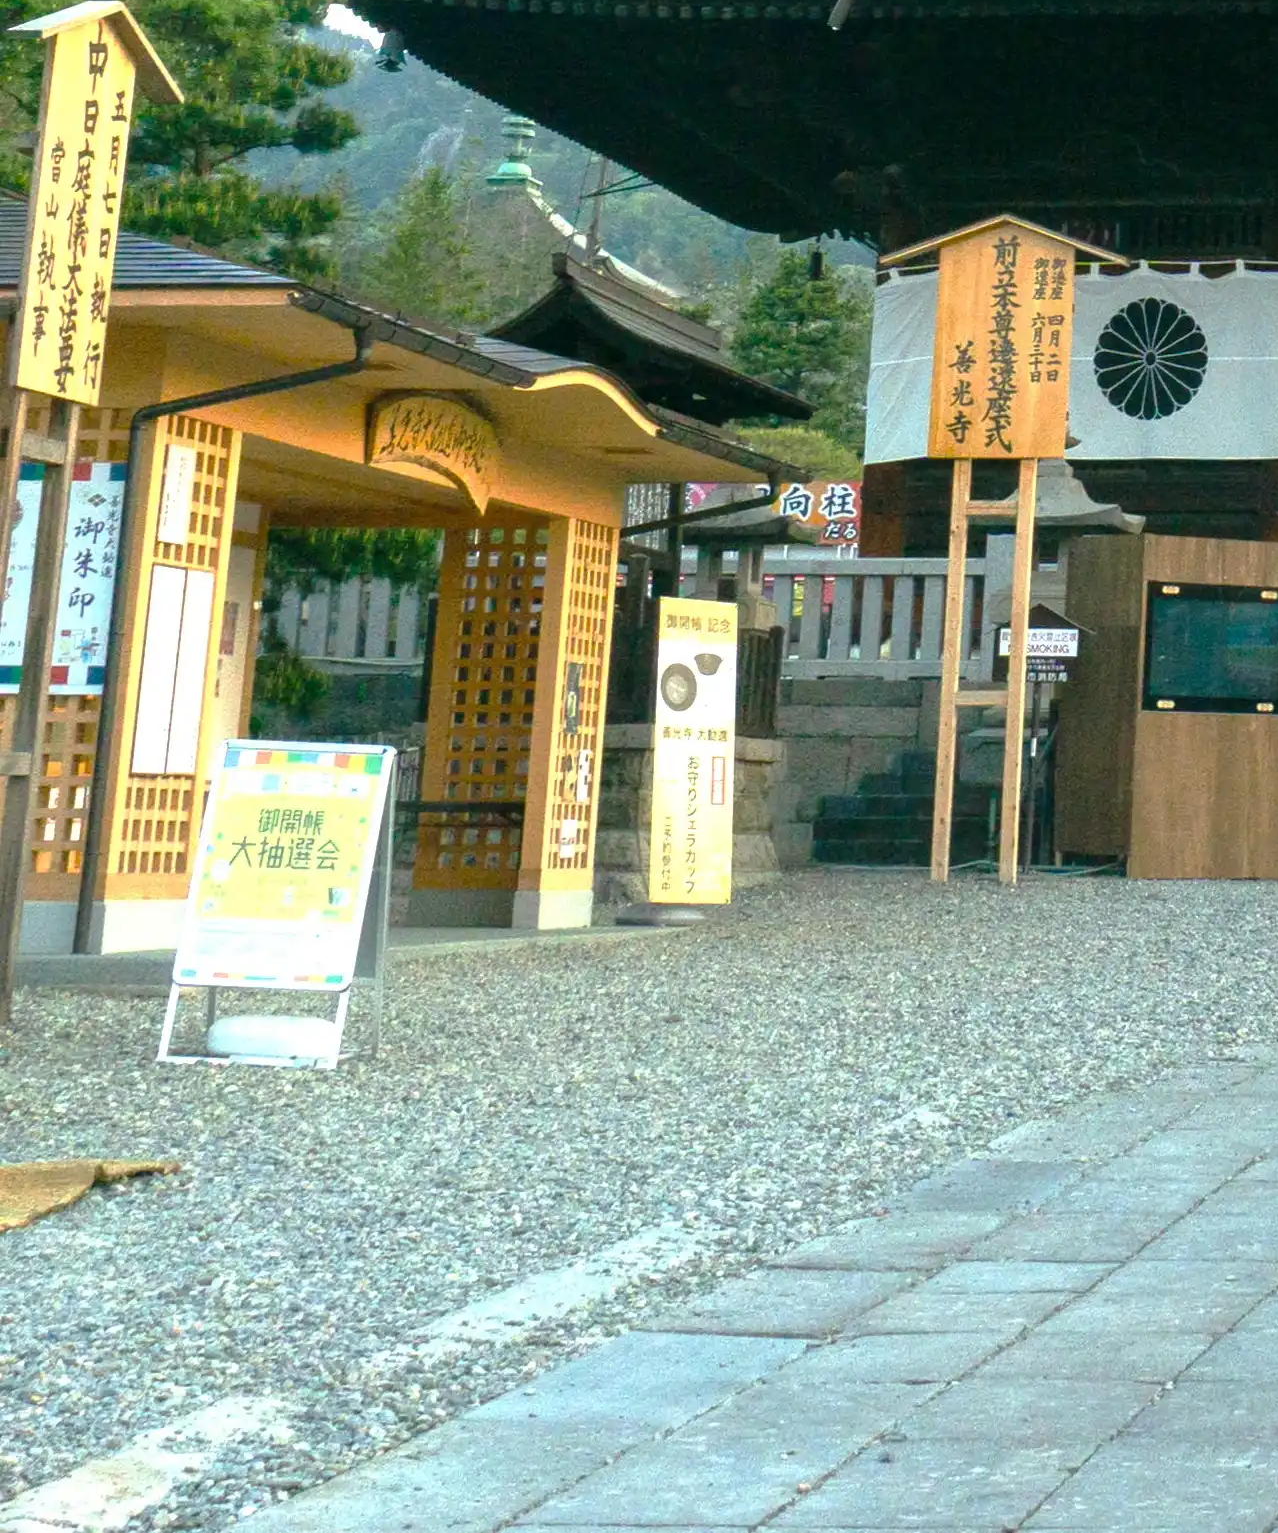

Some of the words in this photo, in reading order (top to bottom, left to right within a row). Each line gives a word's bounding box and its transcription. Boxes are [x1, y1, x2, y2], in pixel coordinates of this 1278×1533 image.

[1028, 312, 1046, 383] 六月三十日
[1046, 314, 1065, 382] 四月二日
[946, 340, 977, 444] 善光寺
[755, 483, 857, 521] 向柱
[68, 518, 105, 618] 御朱印
[228, 835, 340, 872] 大抽選会
[258, 808, 325, 836] 御開帳
